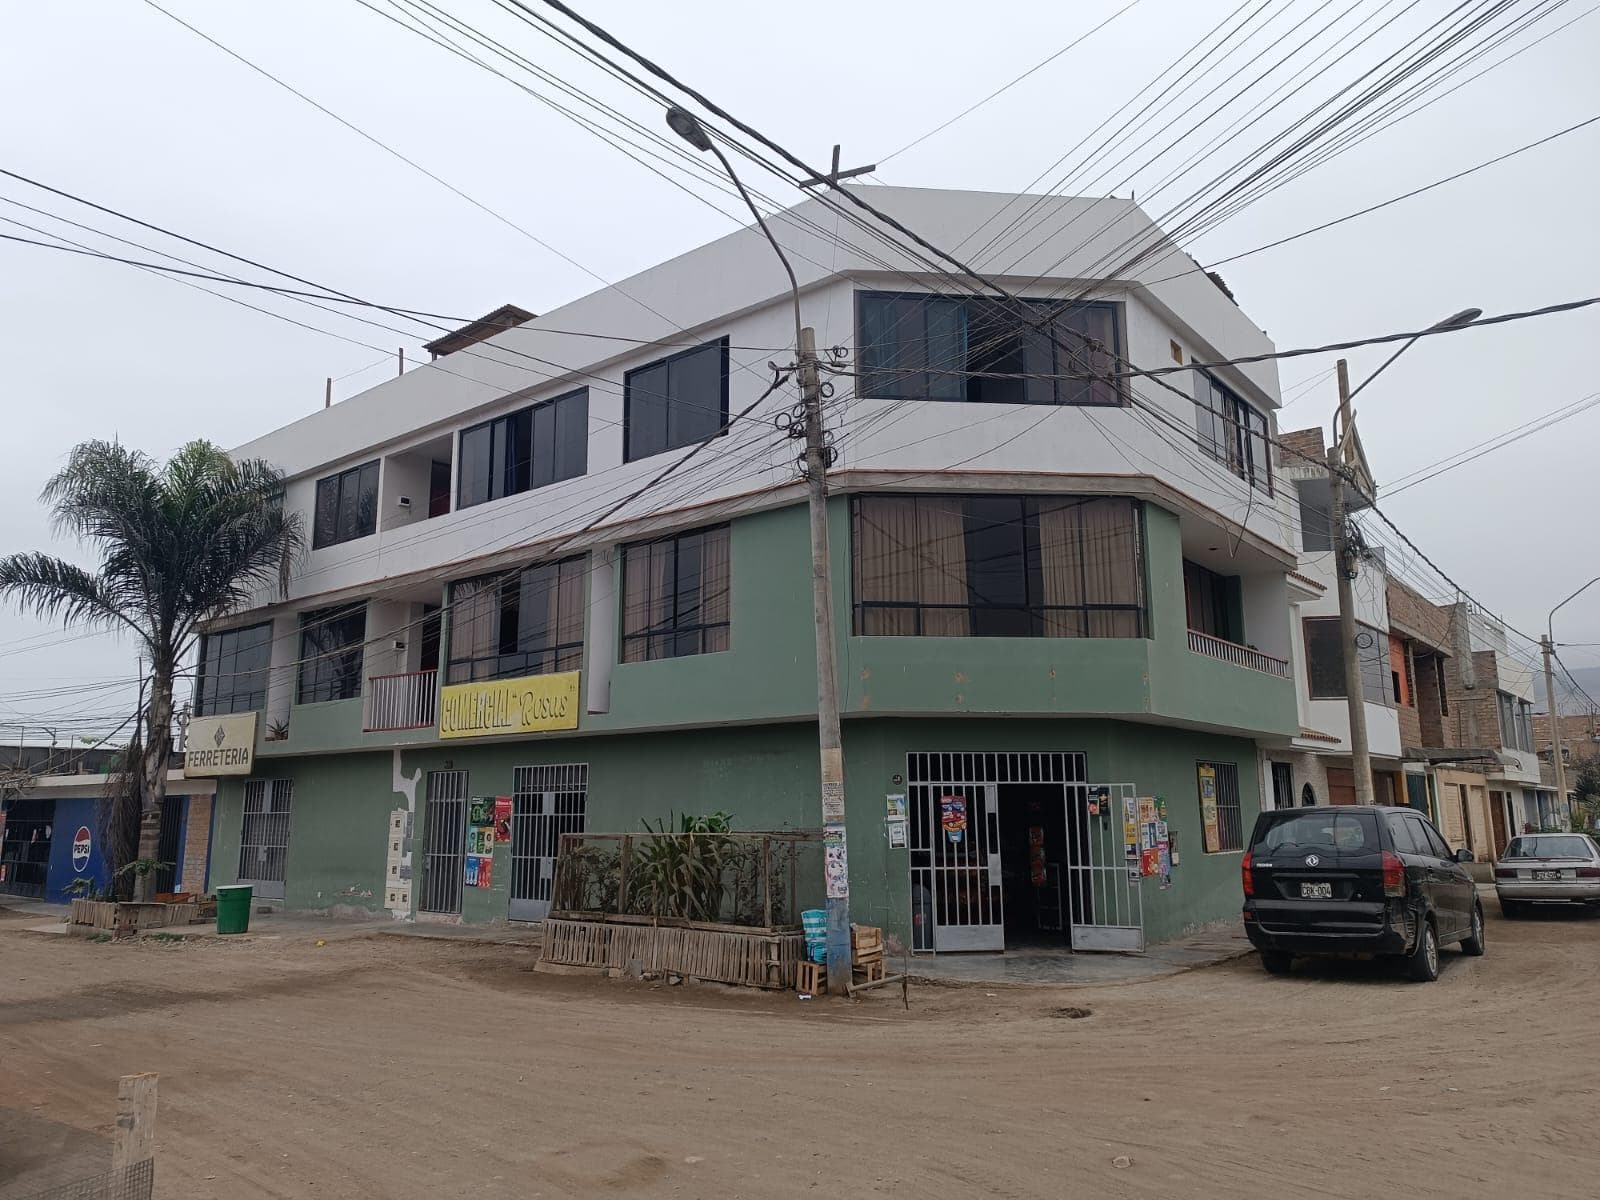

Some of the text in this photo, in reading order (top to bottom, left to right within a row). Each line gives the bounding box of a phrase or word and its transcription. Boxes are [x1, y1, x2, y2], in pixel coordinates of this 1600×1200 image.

[441, 688, 512, 732] COMERCIAL
[187, 747, 249, 767] FERRETERIA
[74, 844, 90, 854] PEPSI
